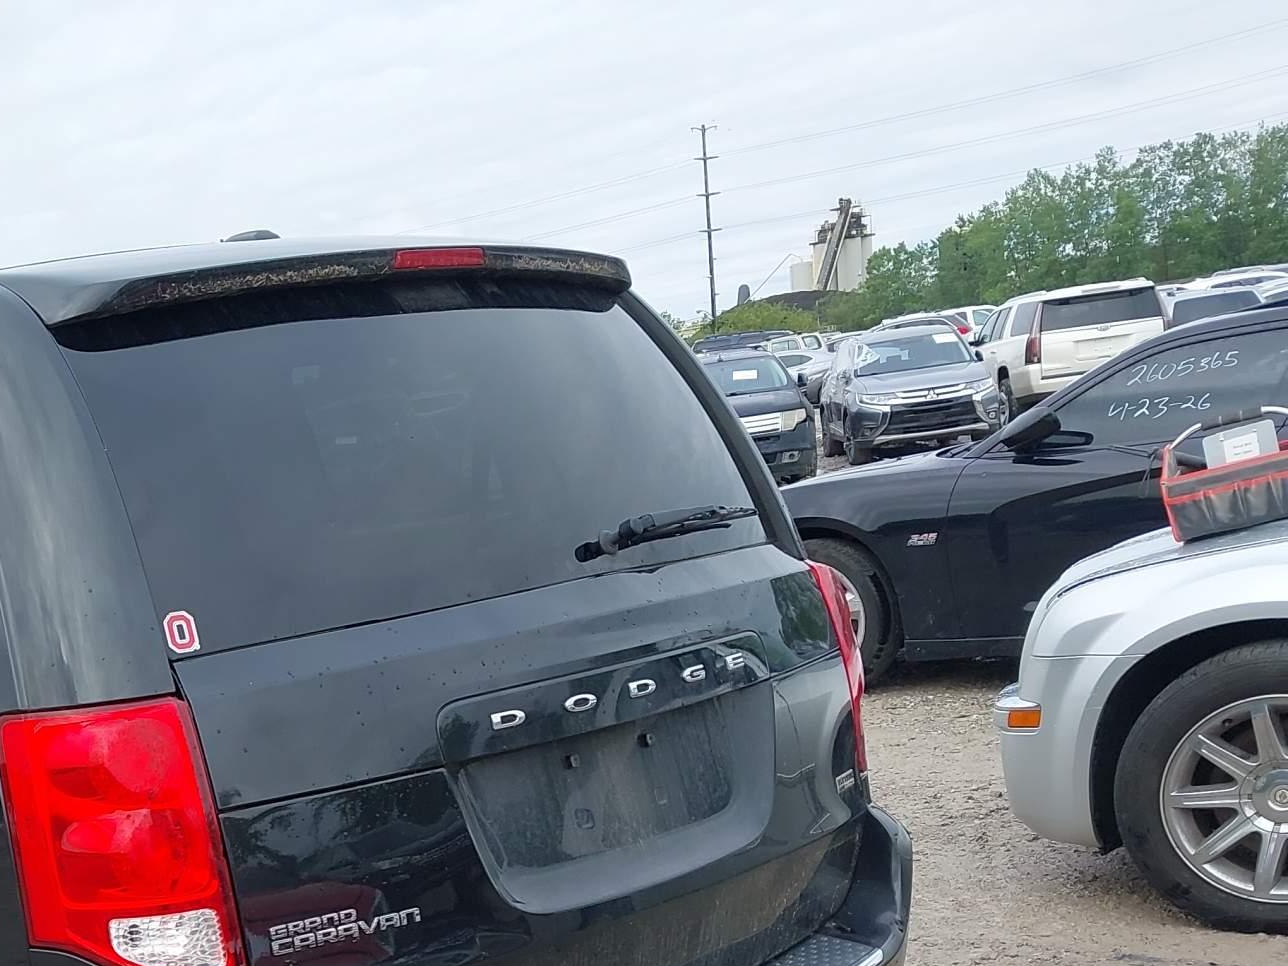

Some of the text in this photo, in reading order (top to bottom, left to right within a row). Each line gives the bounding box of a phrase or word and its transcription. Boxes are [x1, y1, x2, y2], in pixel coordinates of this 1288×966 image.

[1126, 350, 1240, 386] 2605365
[1107, 392, 1212, 421] 4-23-26
[490, 652, 745, 730] DODGE
[269, 908, 358, 940] GRAND
[271, 907, 422, 957] CARAVAN
